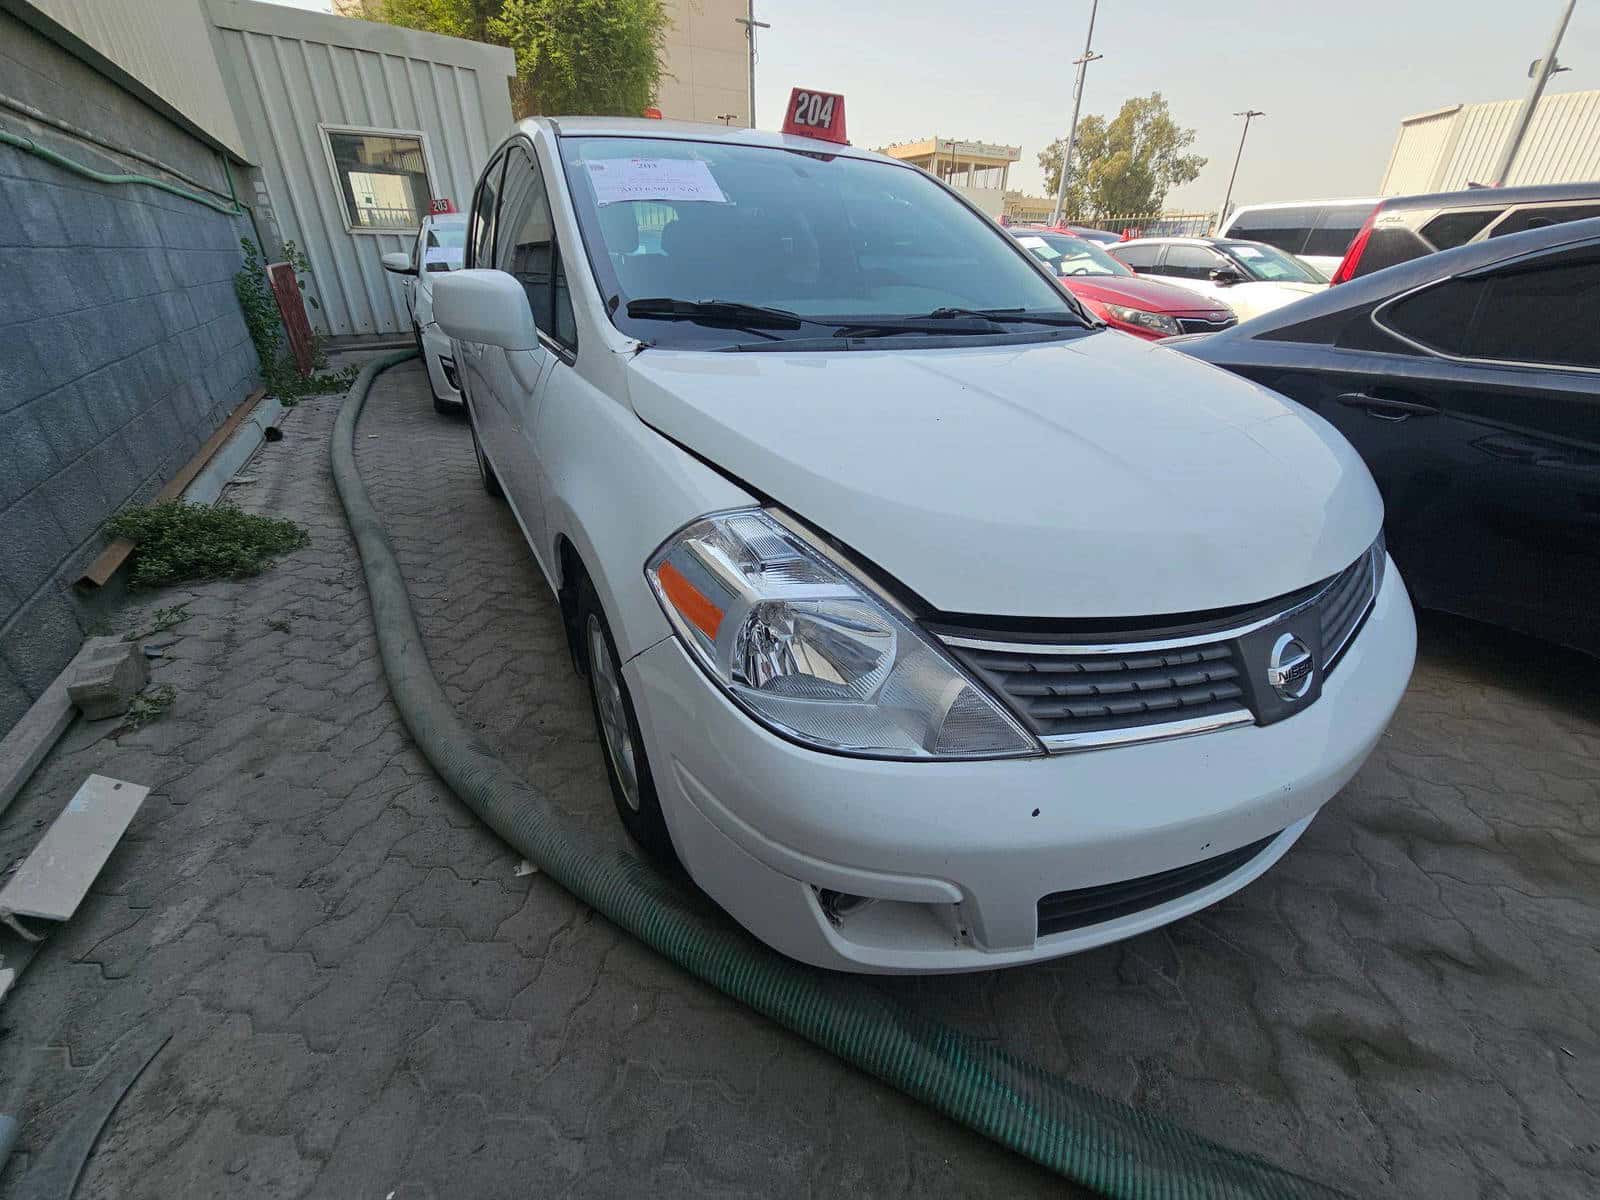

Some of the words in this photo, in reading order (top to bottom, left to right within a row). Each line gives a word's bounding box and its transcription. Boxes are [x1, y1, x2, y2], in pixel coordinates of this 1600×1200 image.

[794, 93, 834, 128] 204
[433, 200, 448, 212] 203
[1278, 663, 1310, 681] NISS
